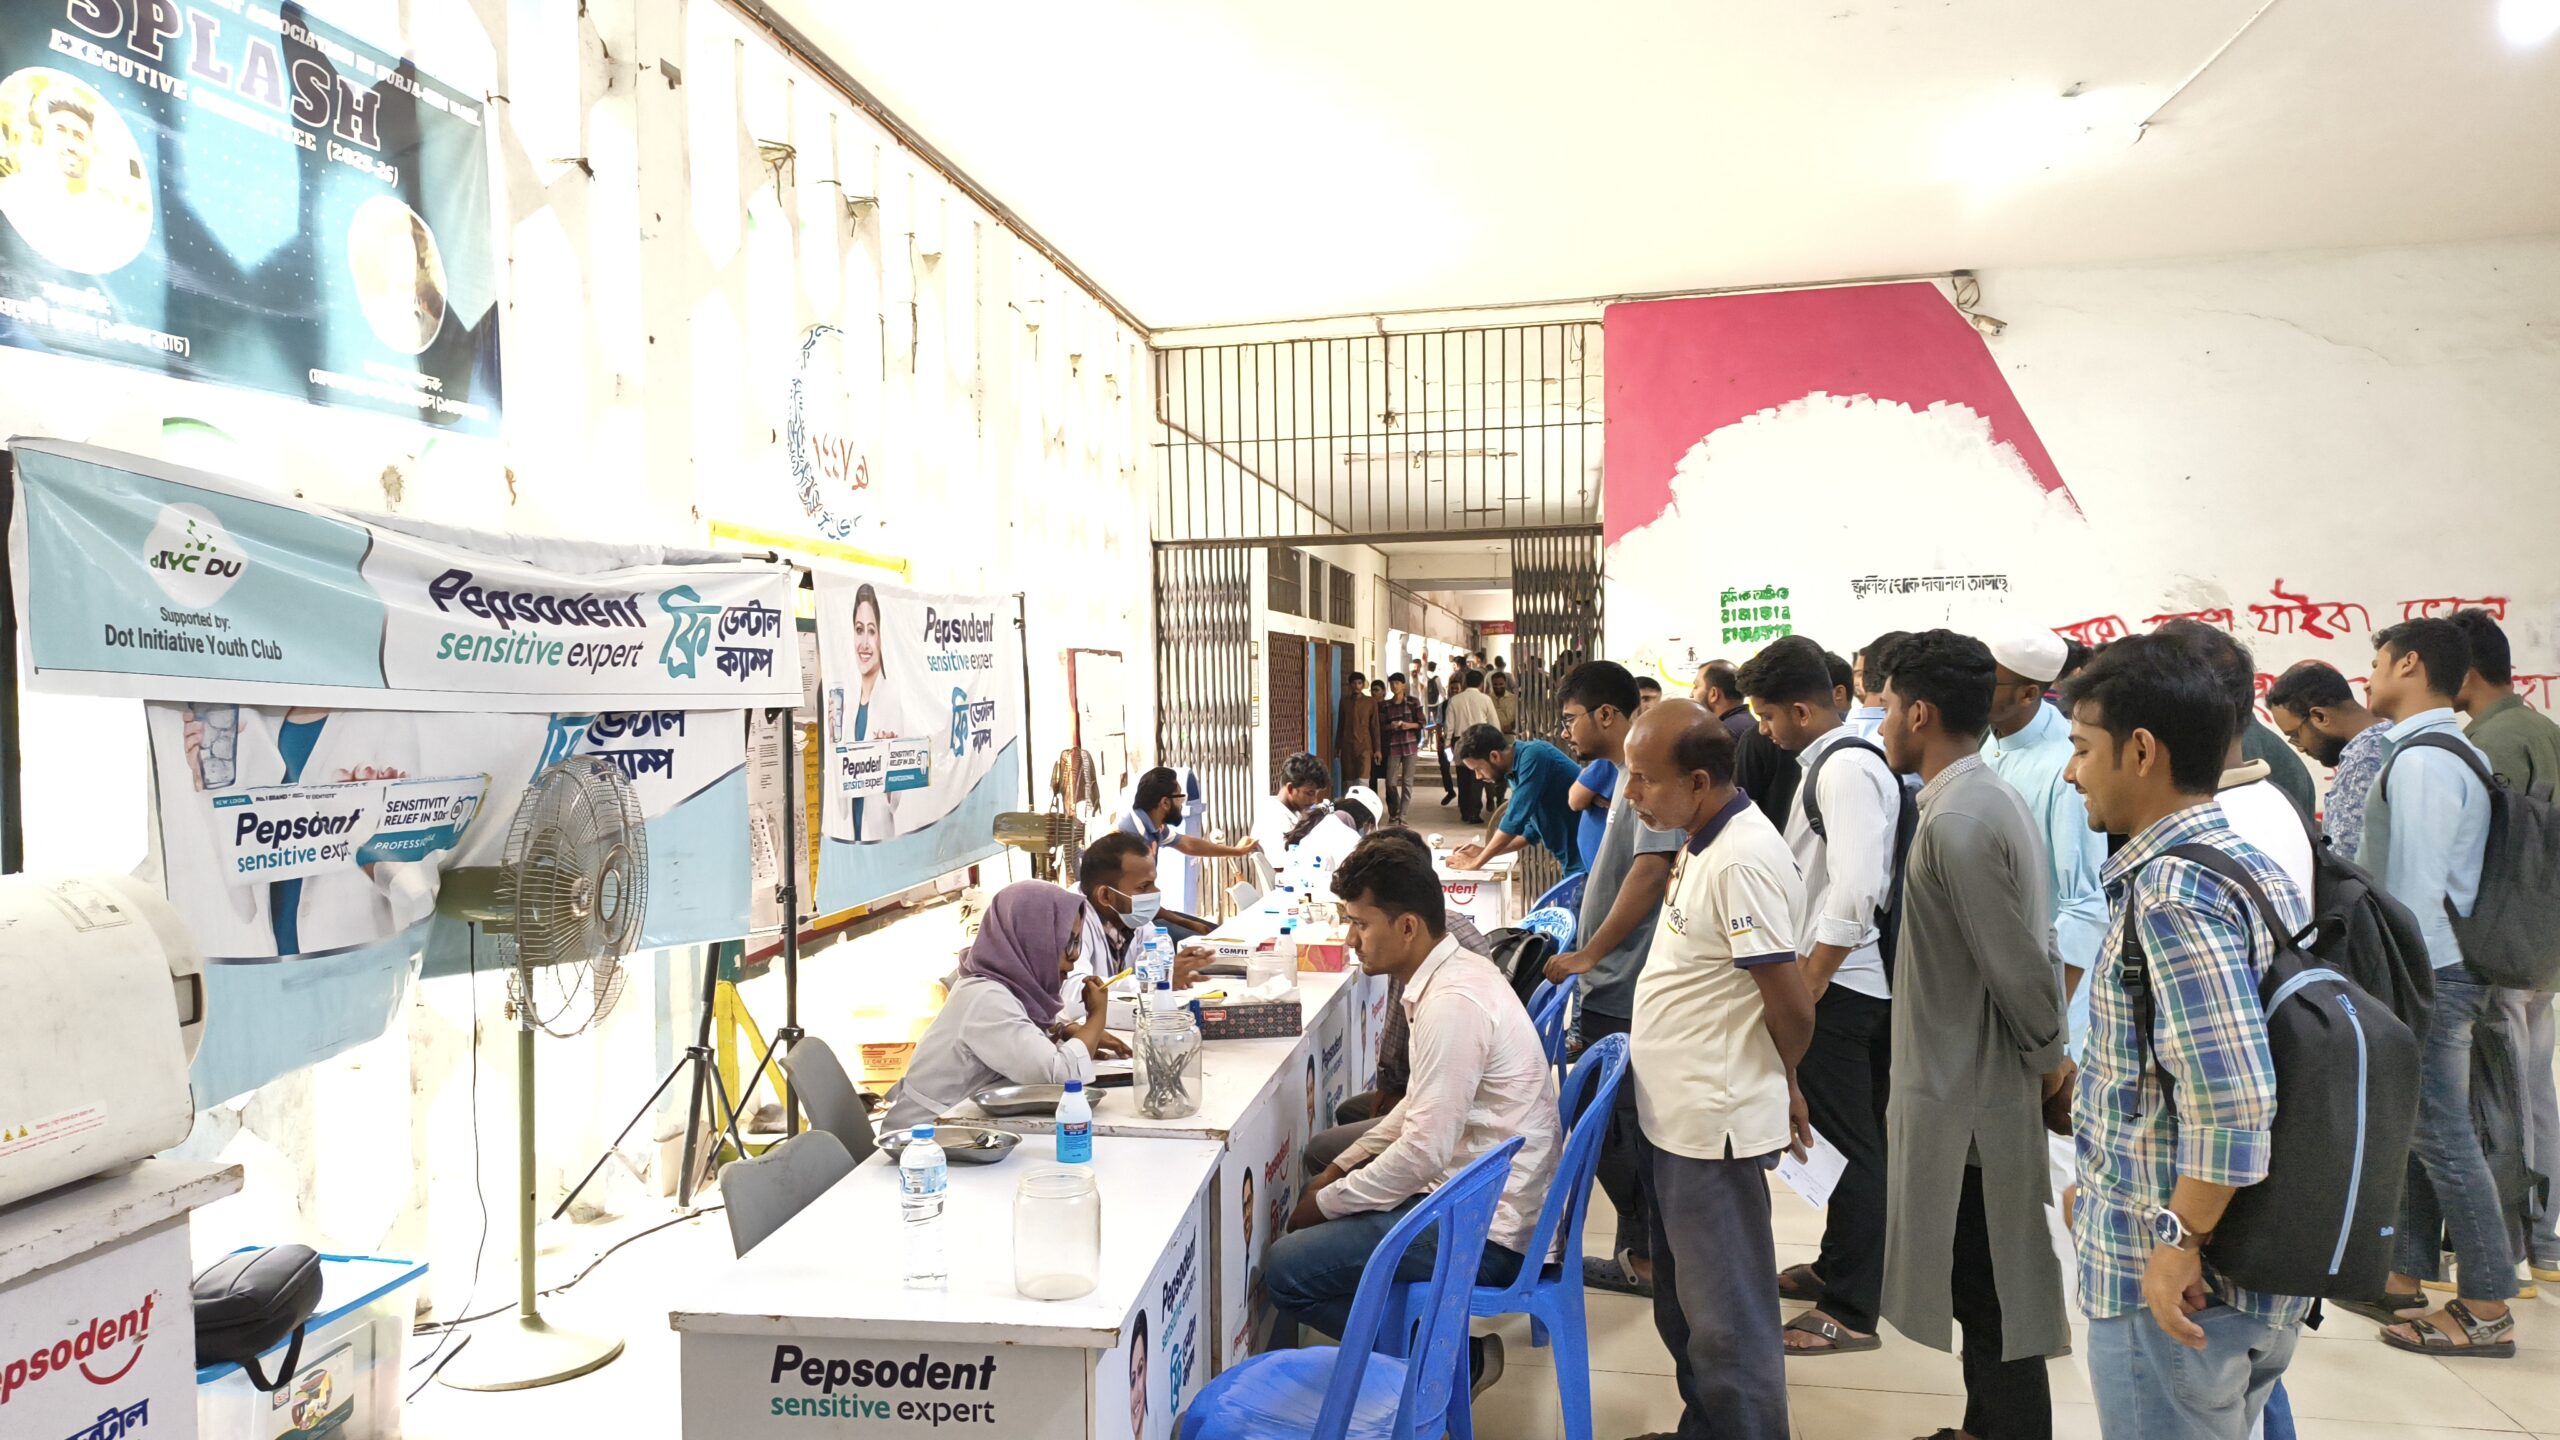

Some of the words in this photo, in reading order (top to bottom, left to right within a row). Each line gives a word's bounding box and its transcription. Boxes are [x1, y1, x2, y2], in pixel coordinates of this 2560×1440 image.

[49, 28, 188, 100] EXECUTIVE
[204, 558, 242, 578] DU
[428, 568, 647, 629] Pepsodent
[160, 607, 212, 629] Supported
[214, 614, 231, 632] by:
[717, 599, 782, 642] ডেন্টাল
[923, 606, 995, 651] Pepsodent
[105, 624, 135, 648] Dot
[138, 626, 204, 653] Initiative
[208, 634, 248, 658] Youth
[252, 639, 282, 661] Club
[436, 629, 564, 666] sensitive
[567, 638, 644, 675] expert
[715, 646, 774, 683] ক্যাম্প
[927, 650, 969, 672] sensitive
[384, 814, 419, 827] RELIEF
[420, 813, 431, 823] IN
[385, 796, 450, 813] SENSITIVITY
[237, 846, 317, 873] sensitive
[1440, 882, 1478, 894] odent
[1731, 915, 1754, 930] BIR
[1219, 947, 1249, 956] COMFIT
[1162, 1224, 1196, 1324] Pepsodent
[0, 1294, 154, 1405] psodent
[770, 1344, 997, 1395] Pepsodent
[770, 1392, 891, 1419] sensitive
[897, 1400, 996, 1427] expert
